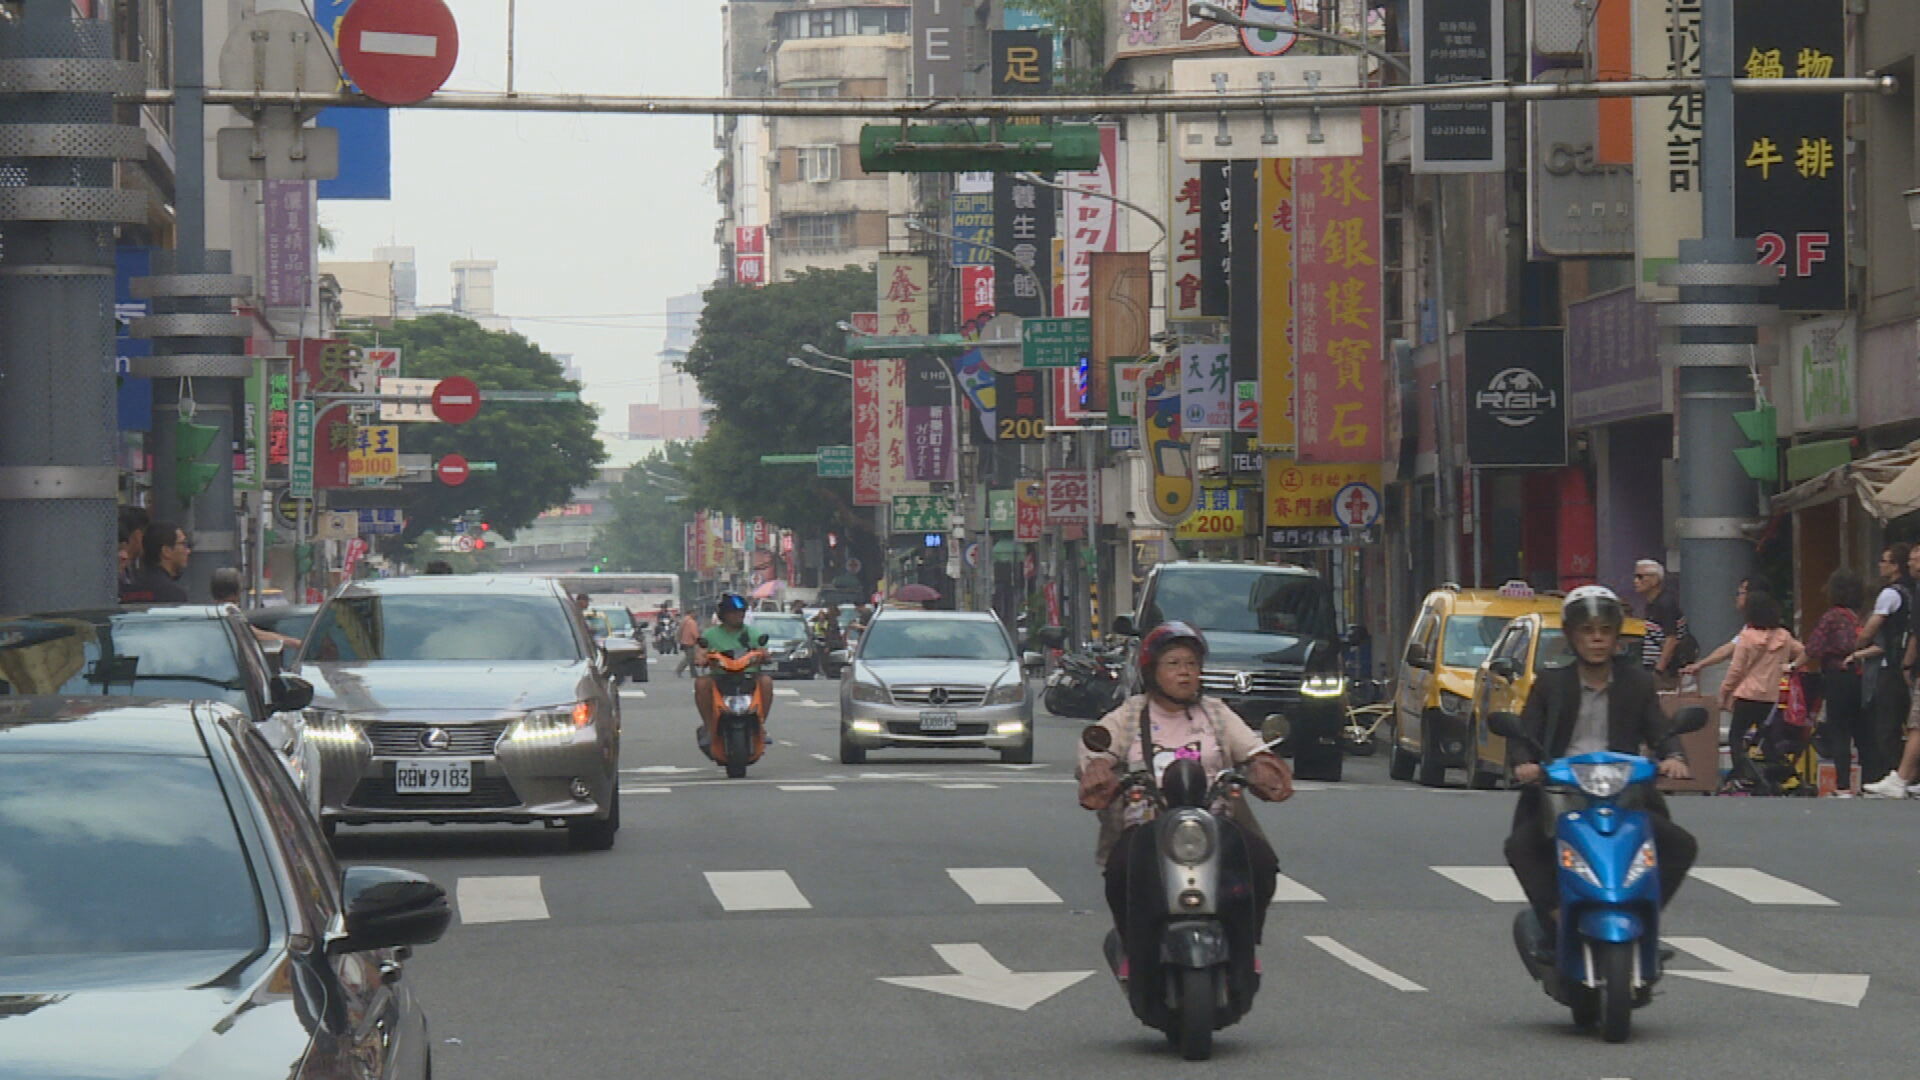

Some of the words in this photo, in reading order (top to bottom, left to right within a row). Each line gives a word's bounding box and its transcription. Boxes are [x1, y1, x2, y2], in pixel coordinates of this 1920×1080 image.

[1004, 46, 1041, 83] 足
[1745, 137, 1835, 180] 牛排
[1756, 232, 1830, 277] 2F
[1320, 119, 1377, 448] 球銀樓寶石
[999, 418, 1046, 440] 200
[1196, 515, 1236, 533] 200
[430, 769, 469, 787] 9183
